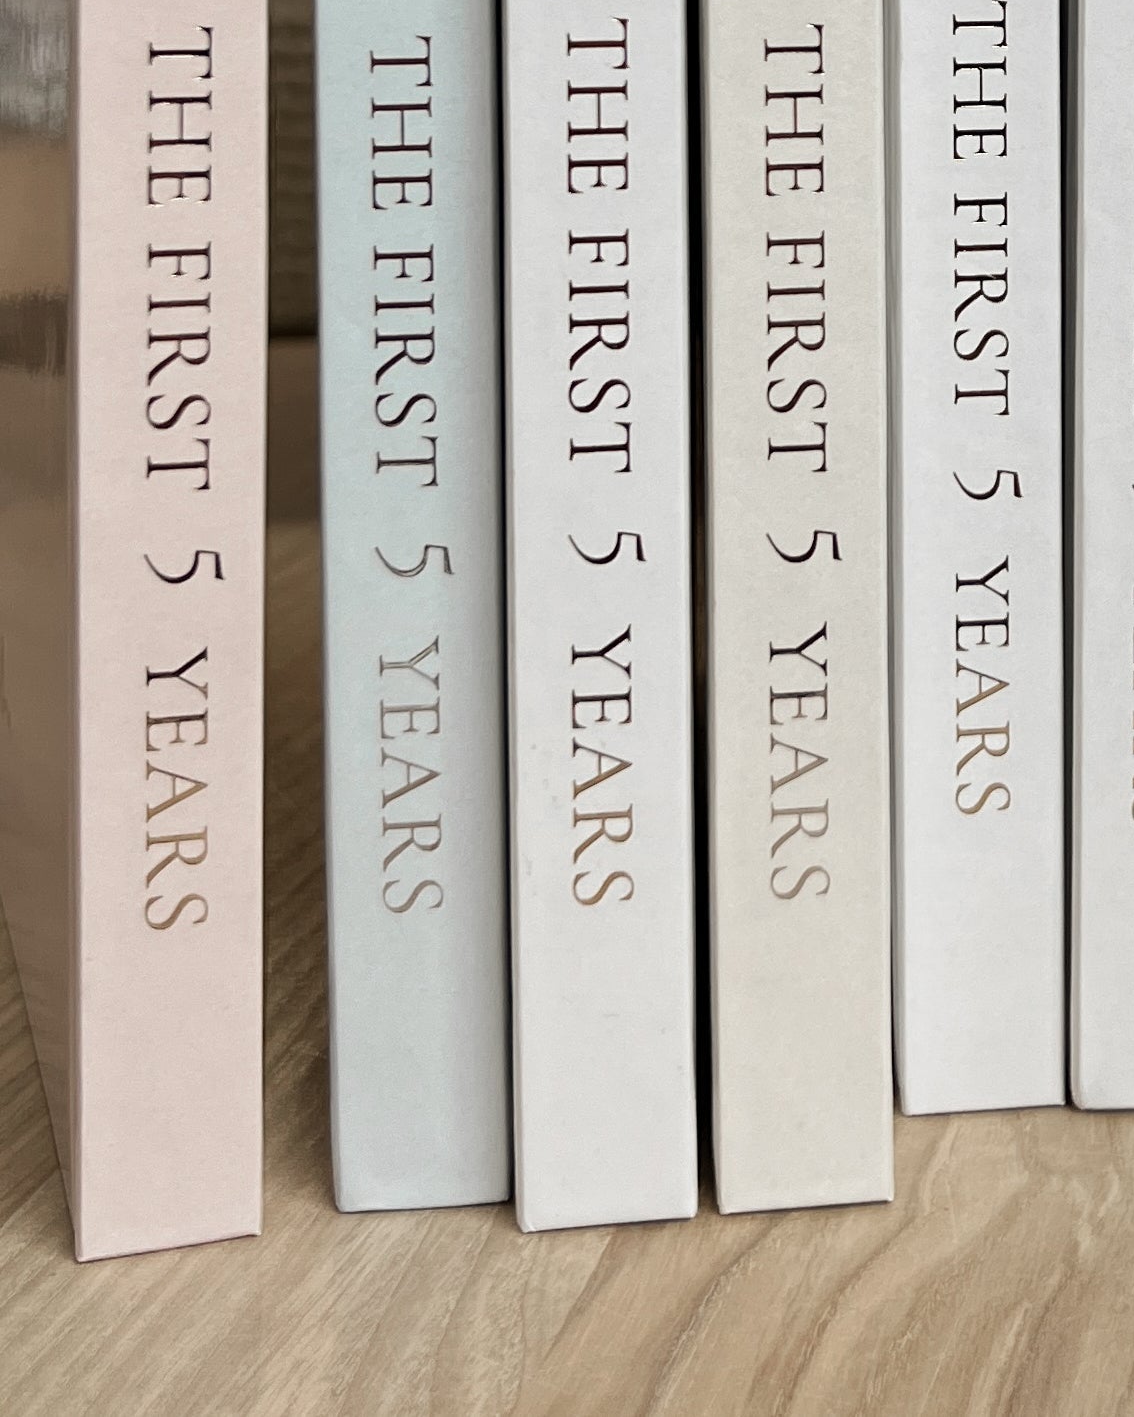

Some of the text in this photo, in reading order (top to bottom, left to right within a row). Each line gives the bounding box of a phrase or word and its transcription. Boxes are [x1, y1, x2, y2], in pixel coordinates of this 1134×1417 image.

[146, 25, 213, 207] THE
[370, 35, 433, 210] THE
[566, 17, 629, 194] THE
[763, 23, 825, 197] THE
[952, 0, 1008, 160] THE
[145, 241, 212, 491] FIRST
[372, 244, 439, 488] FIRST
[567, 228, 632, 473] FIRST
[765, 229, 828, 473] FIRST
[953, 192, 1010, 417] FIRST
[144, 549, 225, 584] 5
[375, 544, 455, 577] 5
[568, 531, 646, 565] 5
[766, 530, 843, 563] 5
[953, 470, 1023, 500] 5
[379, 635, 444, 914] YEARS
[571, 624, 634, 906] YEARS
[769, 621, 831, 899] YEARS
[954, 555, 1011, 815] YEARS
[145, 646, 209, 930] YEARS
